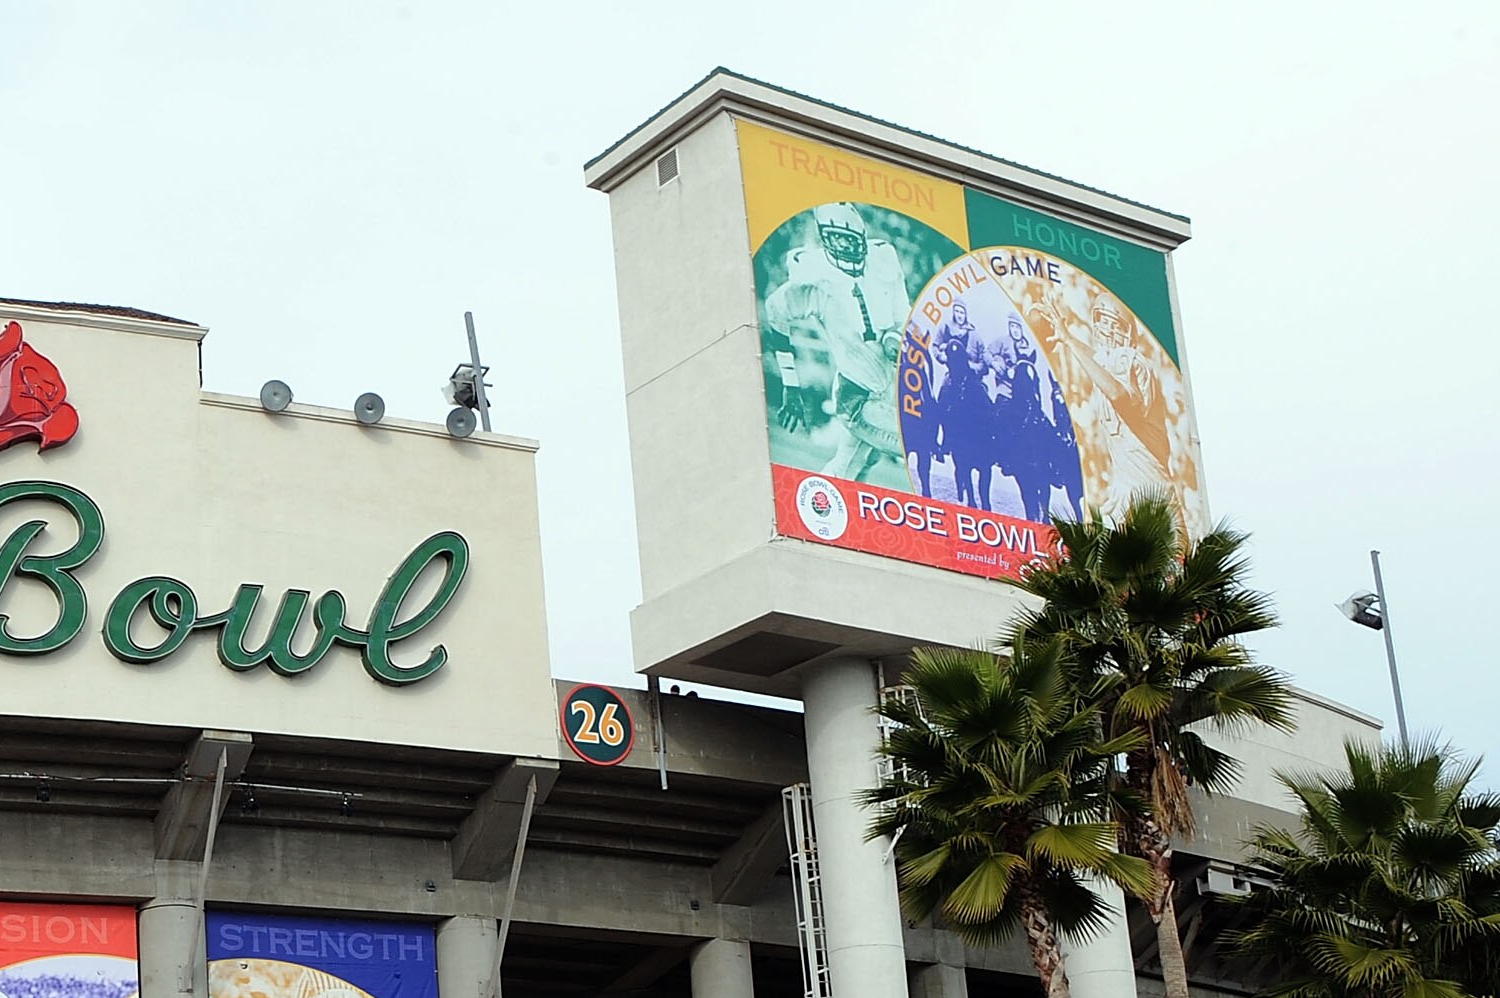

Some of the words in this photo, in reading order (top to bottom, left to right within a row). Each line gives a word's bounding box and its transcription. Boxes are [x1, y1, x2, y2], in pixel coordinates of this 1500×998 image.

[768, 138, 936, 212] TRADITION
[1011, 212, 1123, 270] HONOR
[902, 323, 932, 419] ROSE
[922, 263, 987, 327] BOWL
[990, 255, 1062, 285] GAME
[856, 490, 949, 538] ROSE
[955, 513, 1050, 560] BOWL
[956, 550, 997, 566] presented
[999, 556, 1010, 571] by
[570, 699, 626, 747] 26
[219, 922, 425, 962] STRENGTH
